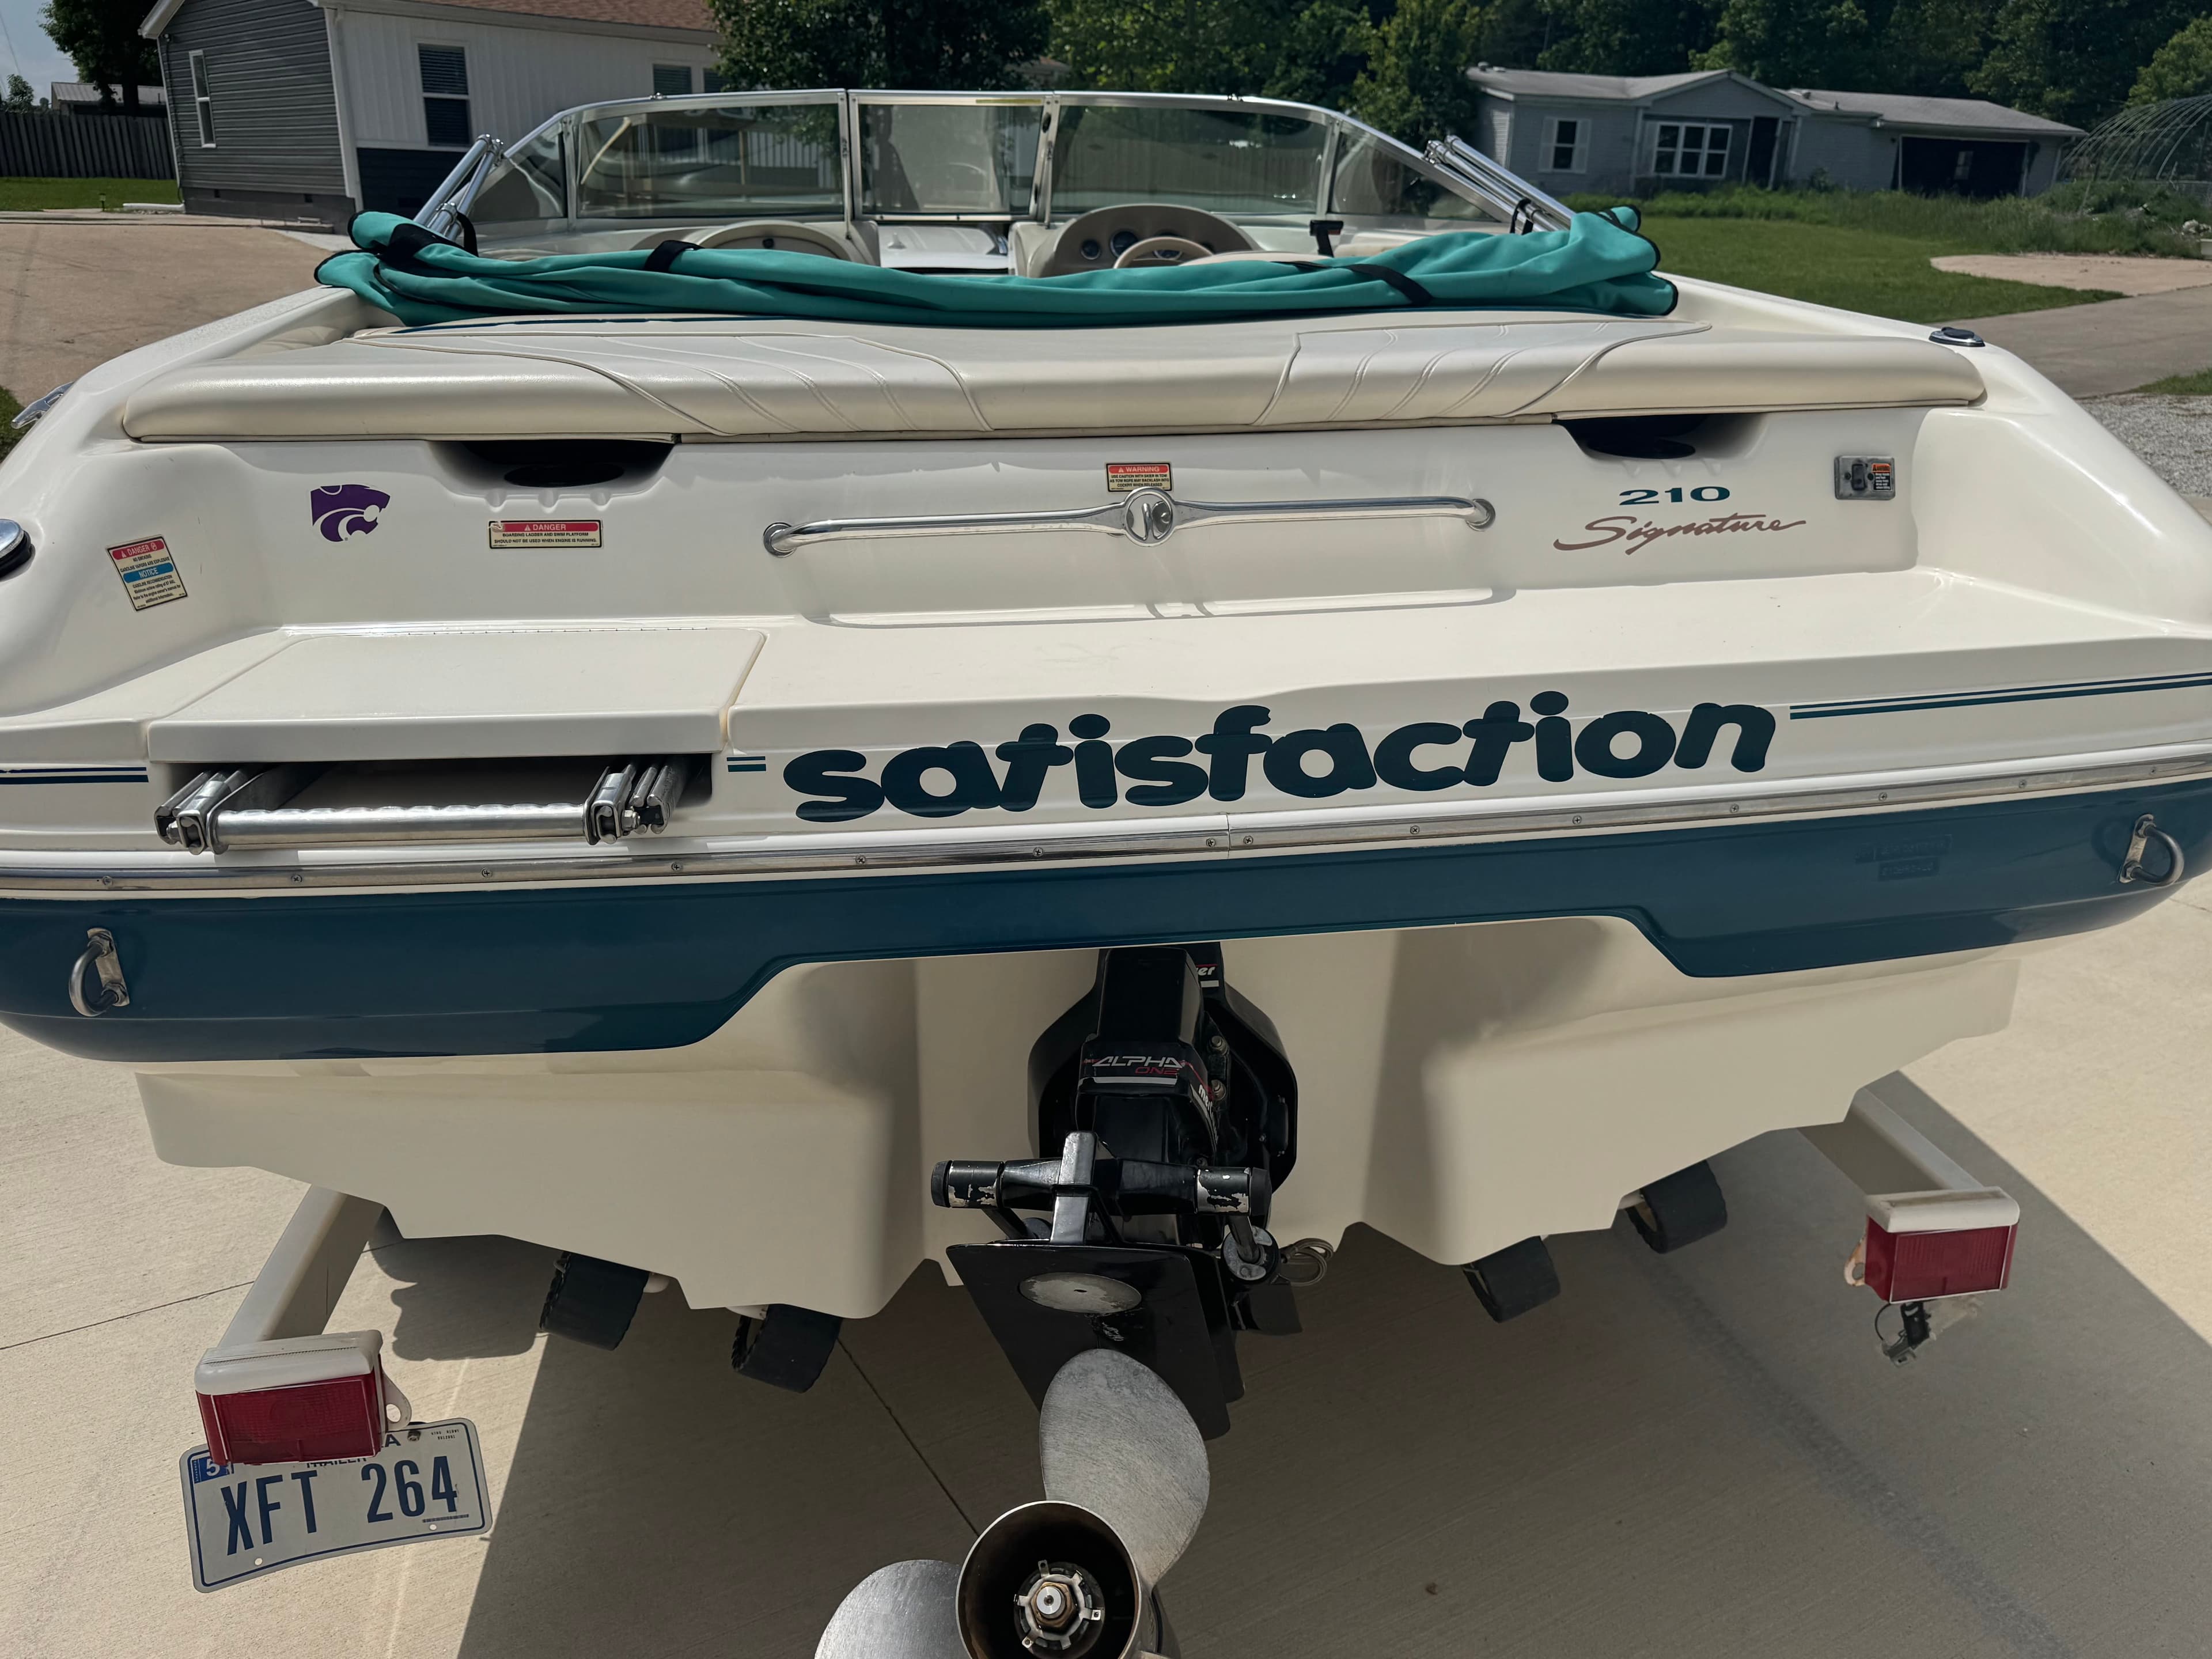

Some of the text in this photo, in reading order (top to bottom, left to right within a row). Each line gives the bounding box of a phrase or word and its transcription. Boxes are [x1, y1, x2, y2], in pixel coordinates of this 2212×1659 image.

[1619, 486, 1730, 505] 210
[1553, 513, 1806, 555] Signature
[128, 545, 150, 554] DANGER
[138, 568, 158, 578] NOTICE
[783, 691, 1776, 823] satisfaction
[1092, 1056, 1183, 1068] ALPHA
[1135, 1067, 1180, 1075] ONE
[220, 1456, 457, 1556] XFT 264
